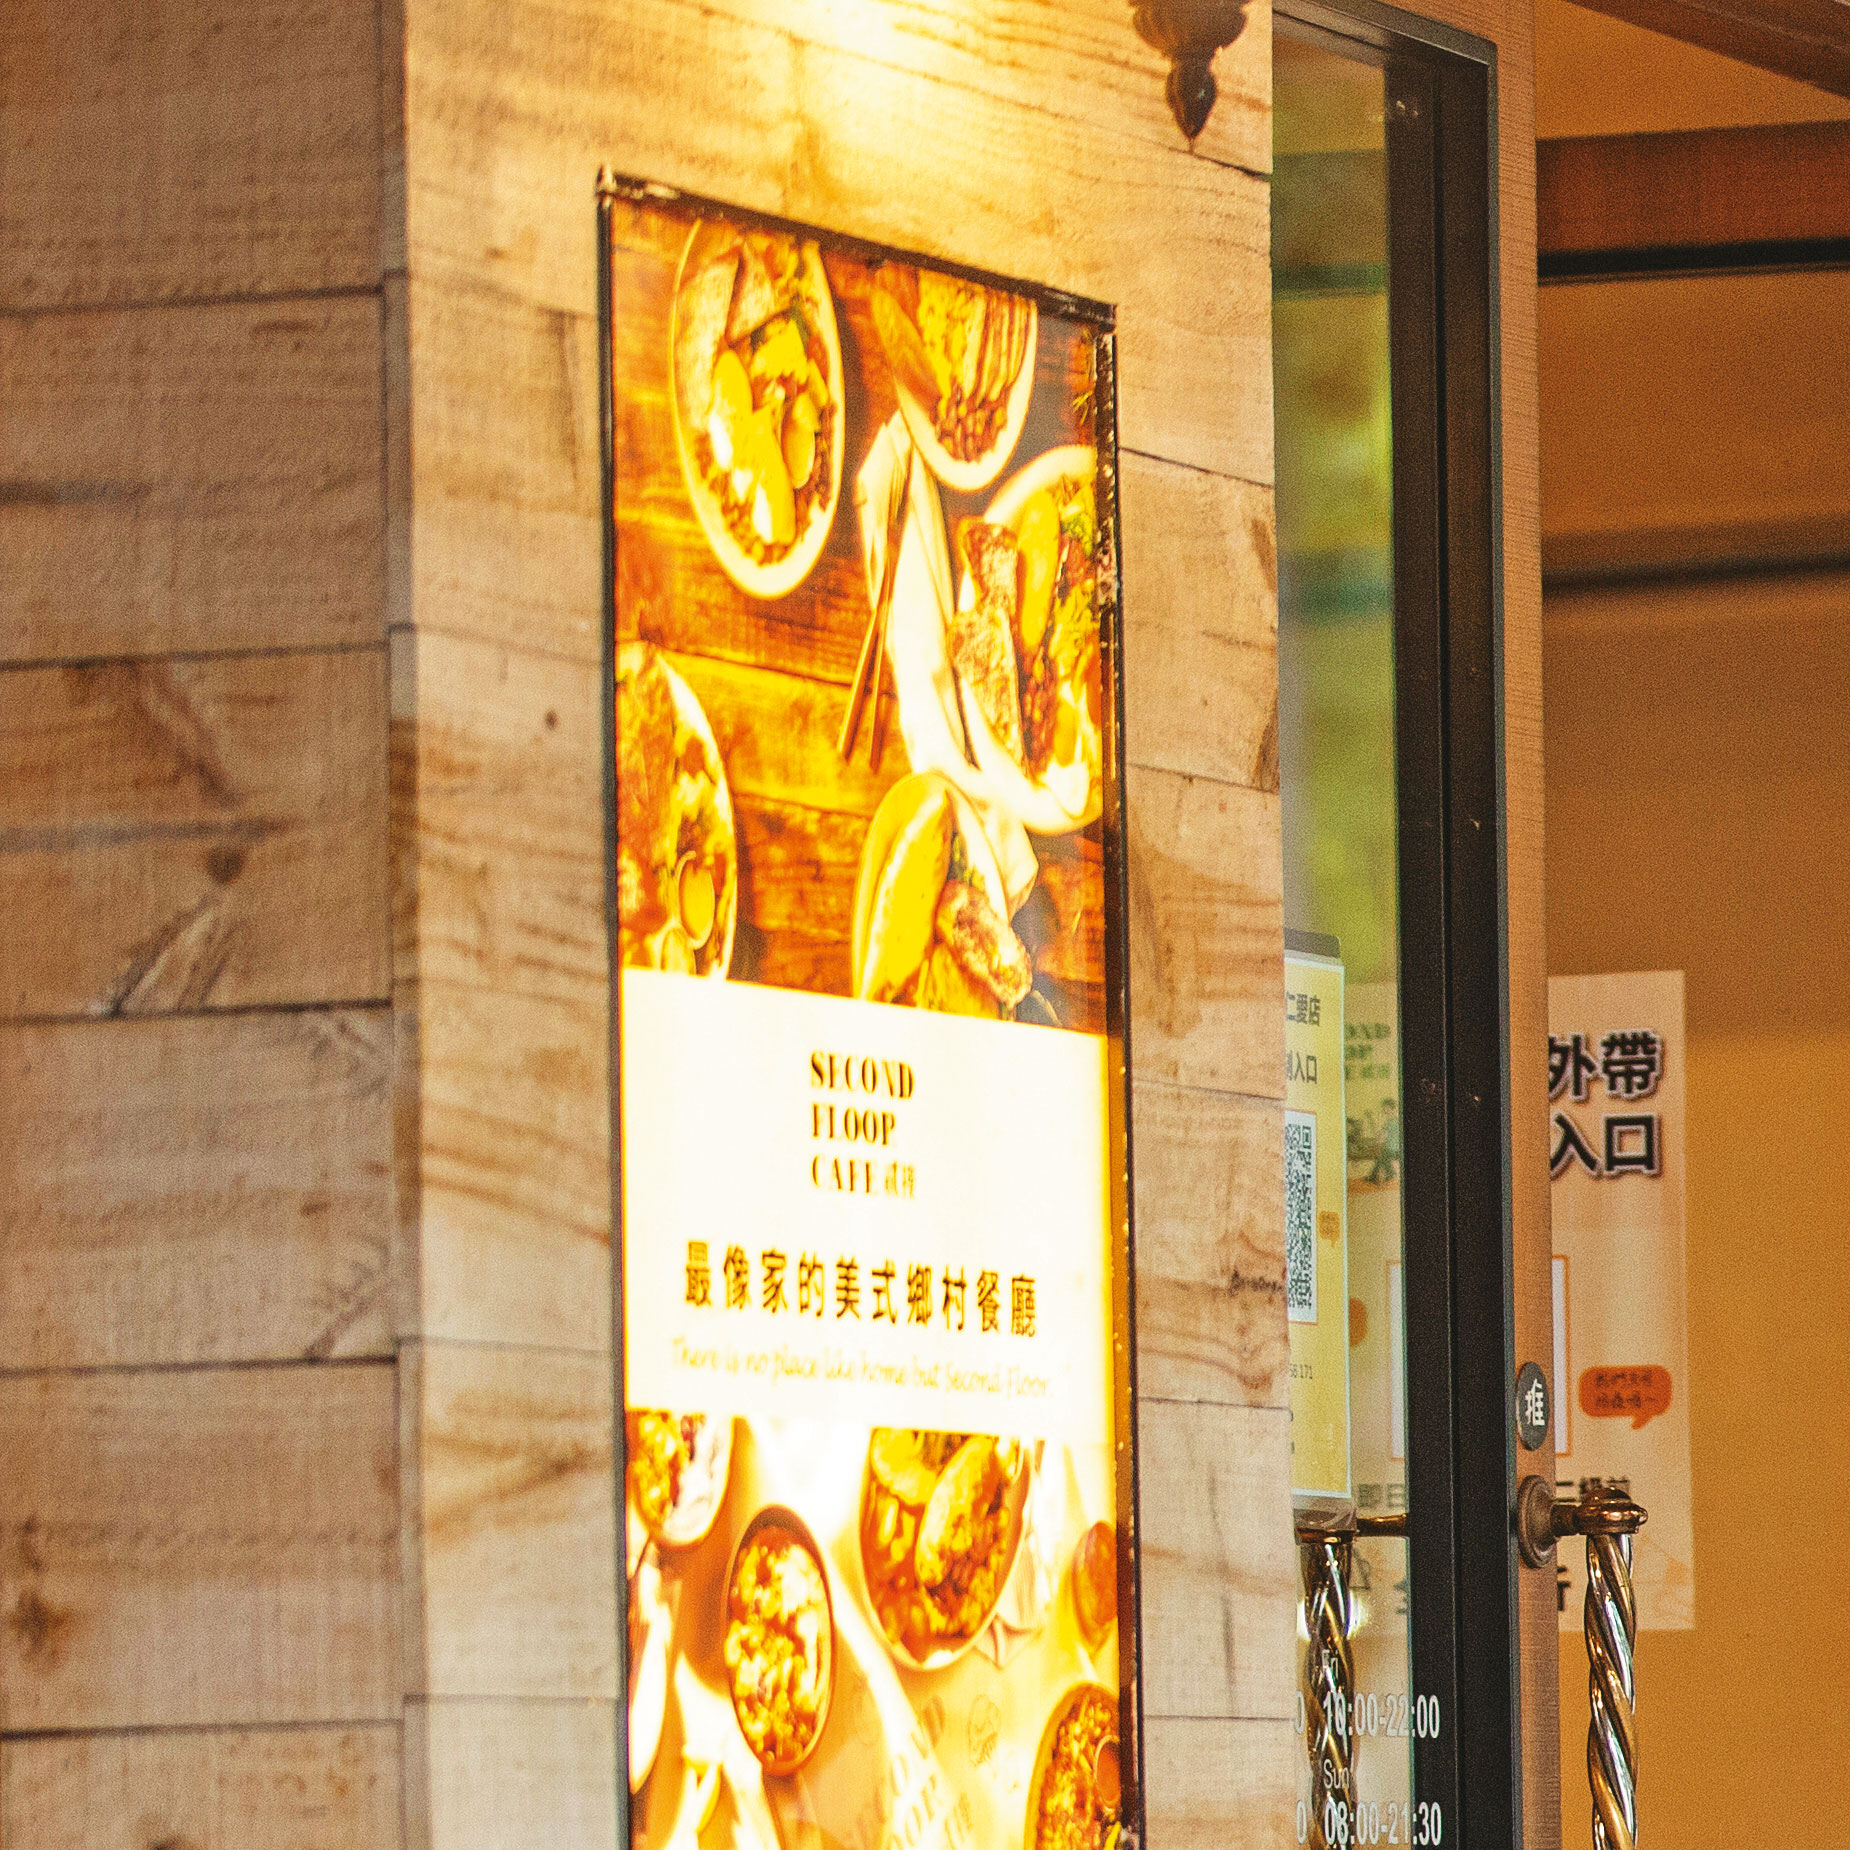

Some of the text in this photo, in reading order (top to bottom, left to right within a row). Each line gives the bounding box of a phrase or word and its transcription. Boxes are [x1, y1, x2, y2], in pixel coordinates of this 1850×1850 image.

[810, 1050, 915, 1099] SECOND
[1549, 1030, 1659, 1096] 外帶
[1549, 1113, 1659, 1174] 入口
[811, 1155, 878, 1196] CAFE
[685, 1239, 1035, 1338] 最像家的美式鄉村餐廳
[1525, 1379, 1545, 1426] 推
[1323, 1758, 1350, 1789] Sun
[1325, 1800, 1442, 1846] 08:00-21:30
